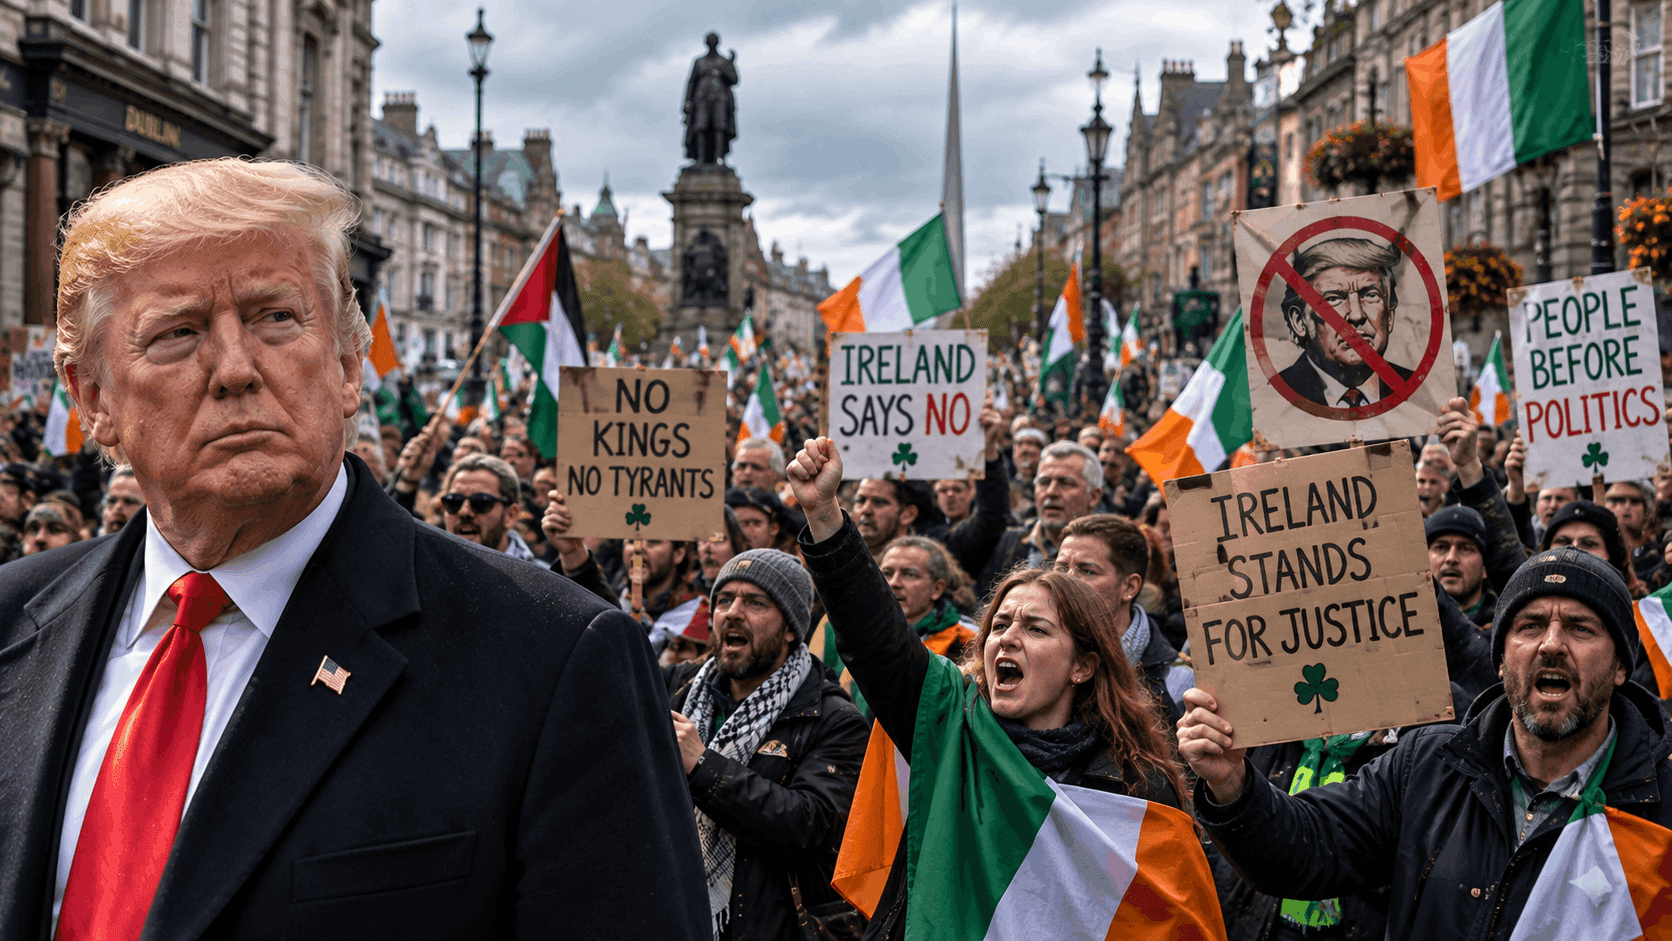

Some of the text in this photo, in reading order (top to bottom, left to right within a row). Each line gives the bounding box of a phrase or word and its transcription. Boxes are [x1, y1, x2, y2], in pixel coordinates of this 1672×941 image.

[1523, 285, 1641, 343] PEOPLE
[840, 344, 976, 386] IRELAND
[1530, 335, 1643, 390] BEFORE
[616, 378, 670, 414] NO
[840, 392, 971, 437] SAYS NO
[1525, 385, 1660, 444] POLITICS
[593, 419, 691, 458] KINGS
[568, 465, 714, 499] NO TYRANTS
[1210, 476, 1378, 542] IRELAND
[1227, 537, 1372, 600] STANDS
[1202, 591, 1425, 666] FOR JUSTICE
